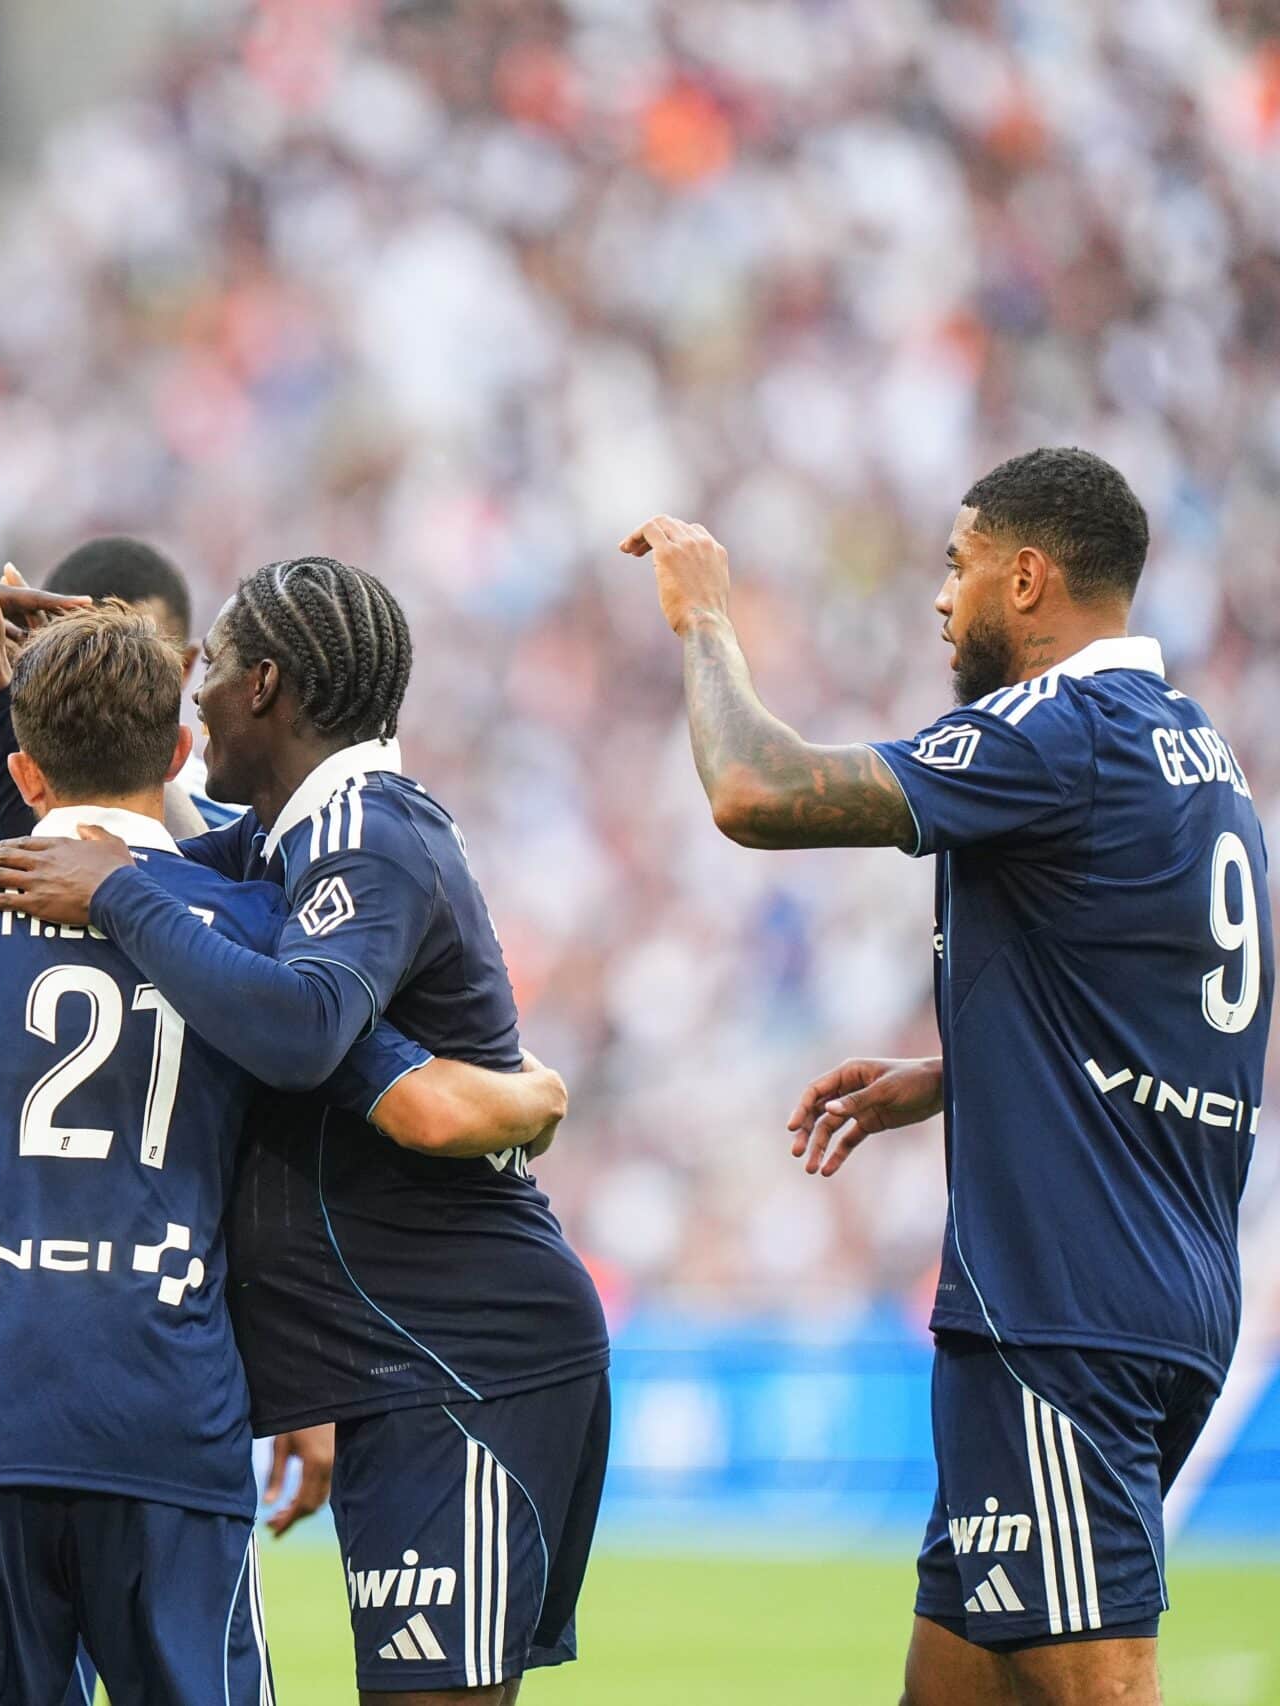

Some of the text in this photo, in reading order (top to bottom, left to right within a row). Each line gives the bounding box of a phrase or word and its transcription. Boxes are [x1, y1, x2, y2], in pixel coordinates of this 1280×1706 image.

[1201, 831, 1261, 1034] 9
[19, 964, 185, 1170] 21
[1083, 1057, 1245, 1133] VINCI
[947, 1496, 1032, 1556] win
